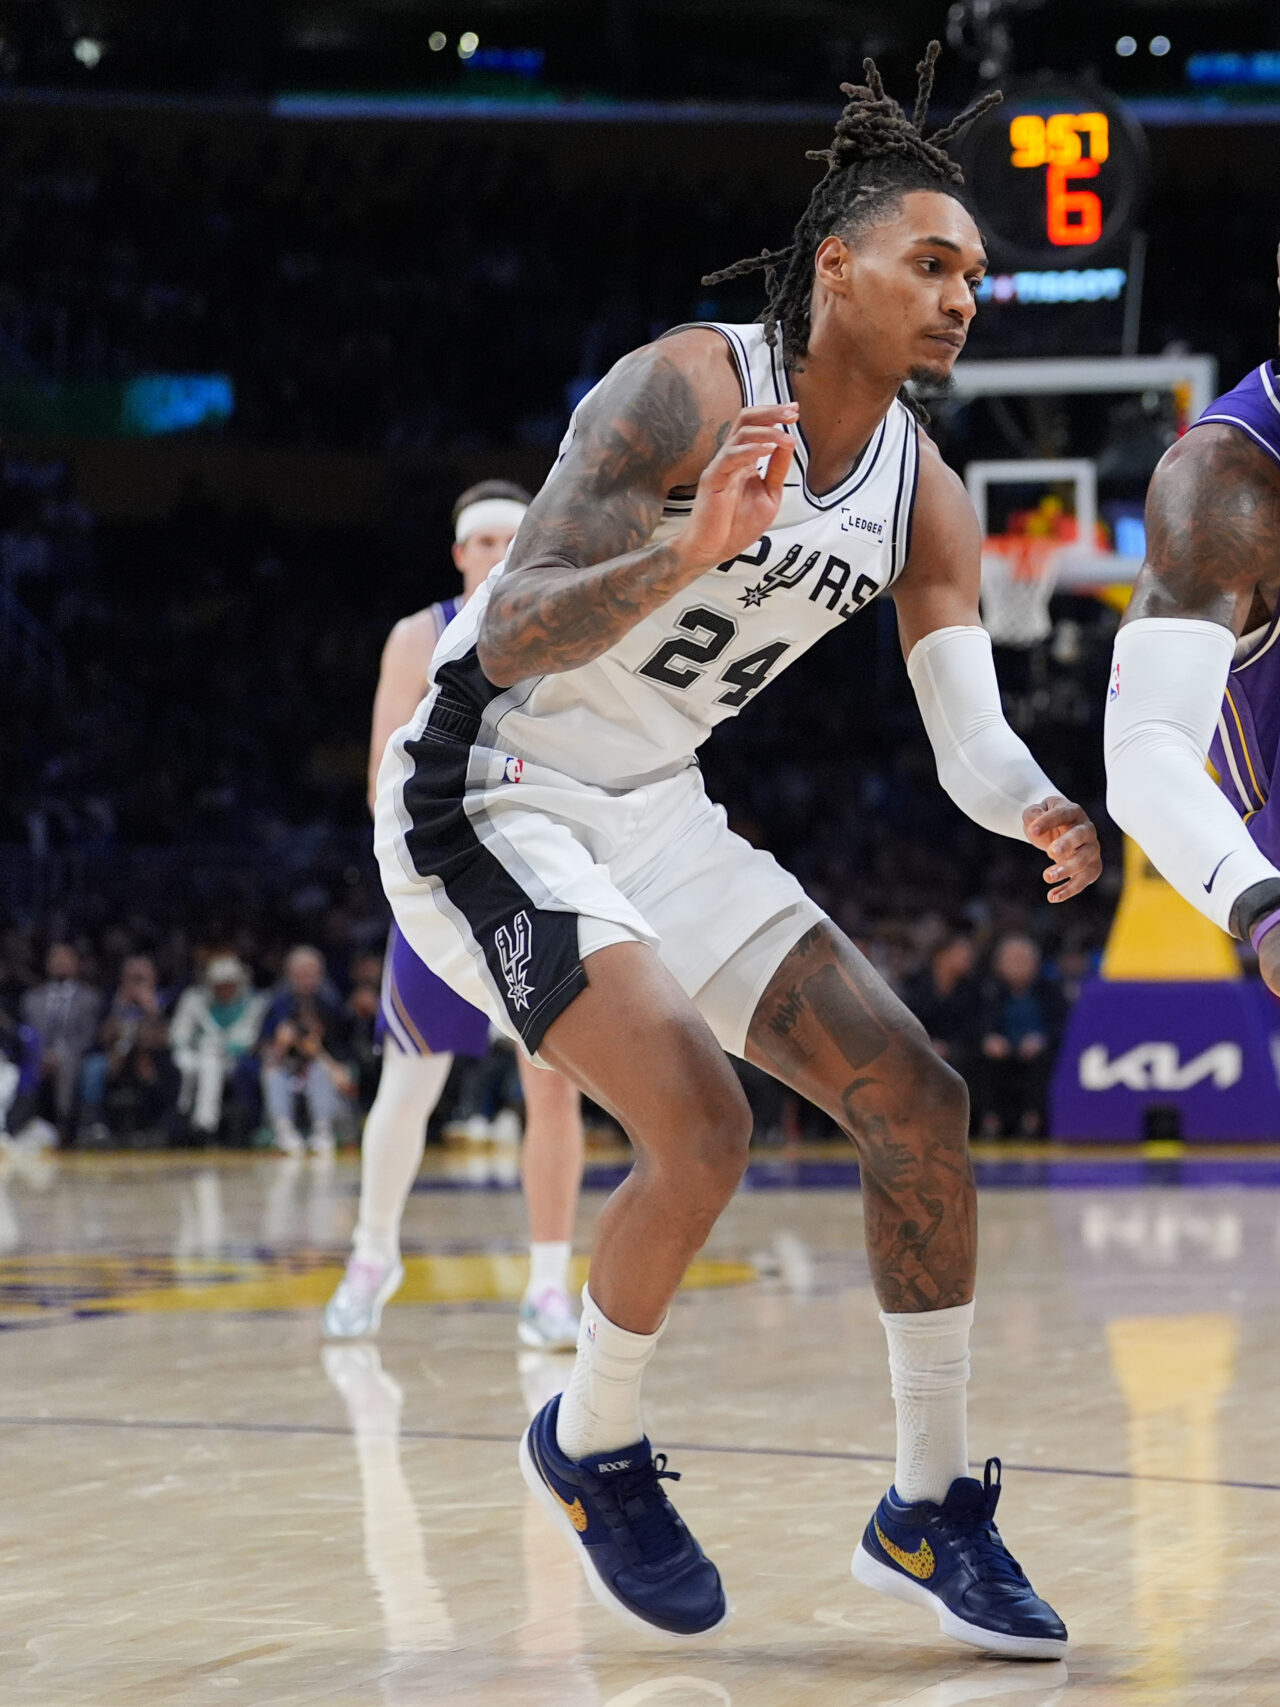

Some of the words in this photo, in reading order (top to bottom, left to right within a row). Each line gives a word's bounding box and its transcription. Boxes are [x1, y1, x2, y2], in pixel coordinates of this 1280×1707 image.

[1046, 158, 1102, 246] 6
[848, 515, 883, 536] LEDGER
[716, 536, 880, 619] PURS
[634, 603, 792, 709] 24
